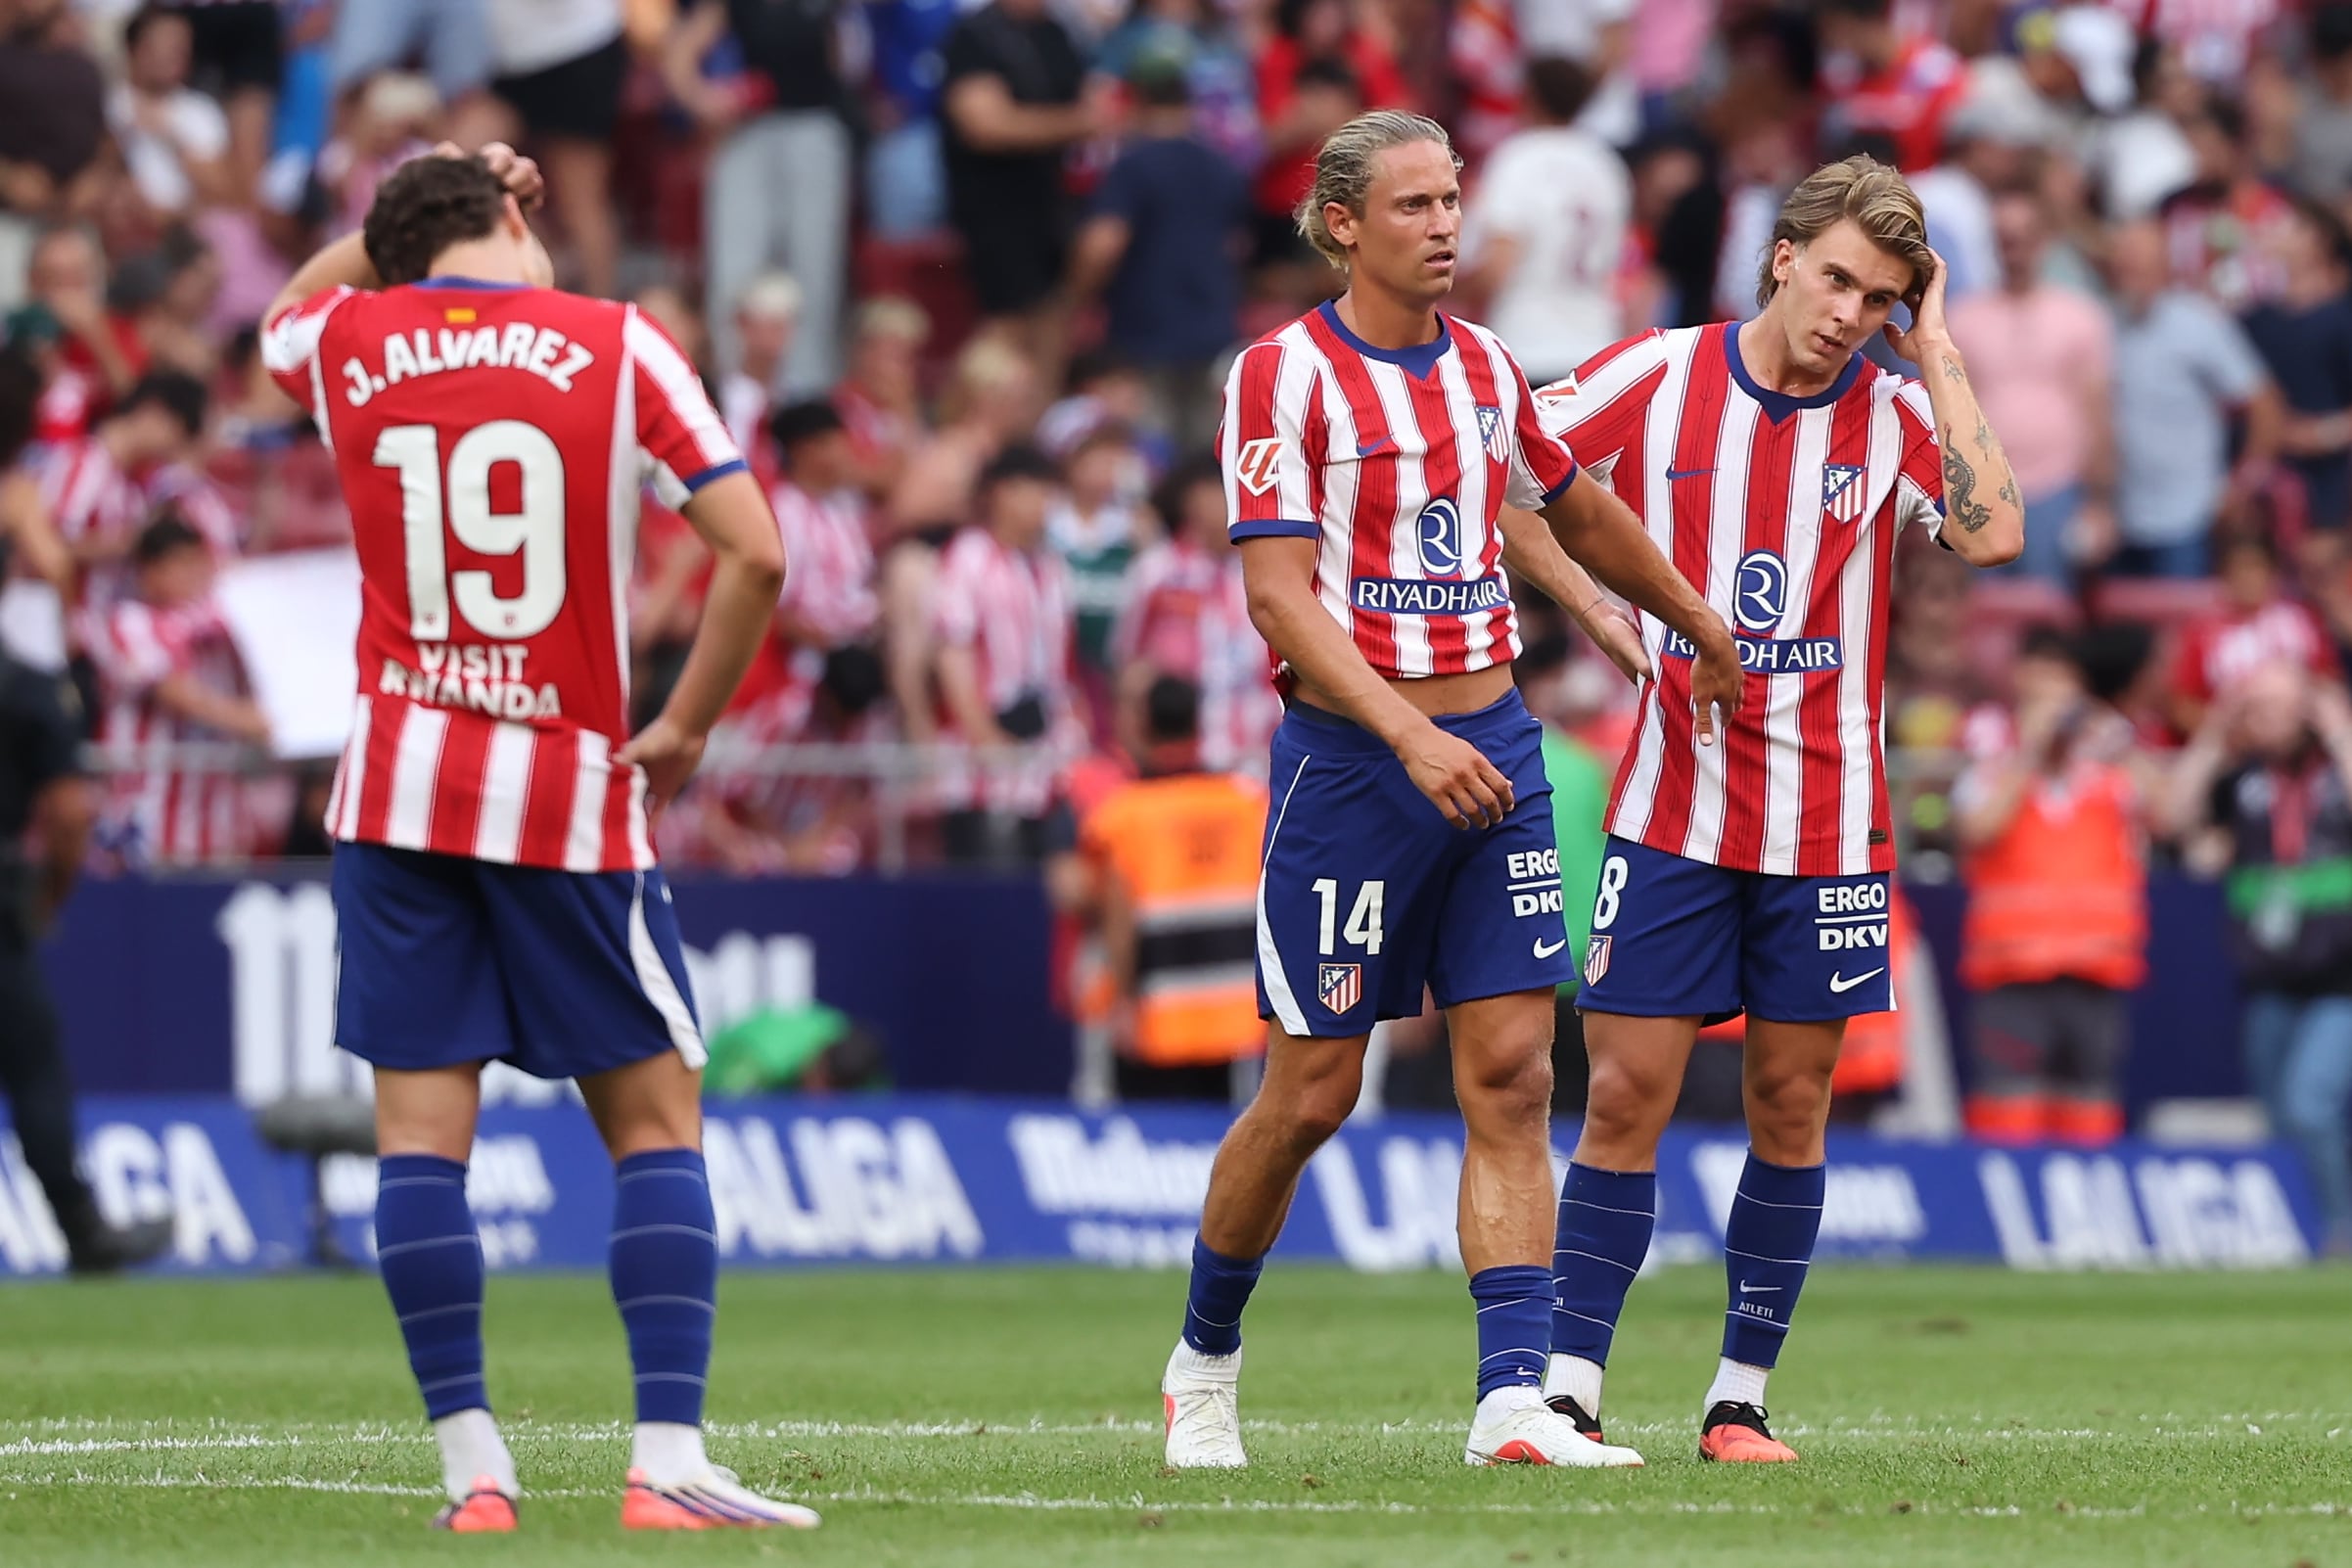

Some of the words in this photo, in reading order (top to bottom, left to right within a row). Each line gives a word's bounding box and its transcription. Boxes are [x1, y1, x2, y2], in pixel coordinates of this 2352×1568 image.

[342, 321, 595, 407] J.ALVAREZ
[372, 419, 568, 641] 19
[418, 642, 529, 682] VISIT
[1669, 629, 1778, 669] RDH
[1784, 641, 1838, 669] AIR
[1311, 877, 1385, 956] 14
[1818, 882, 1886, 913] ERGO
[1819, 924, 1888, 950] DKV
[1737, 1301, 1775, 1318] ATLETI
